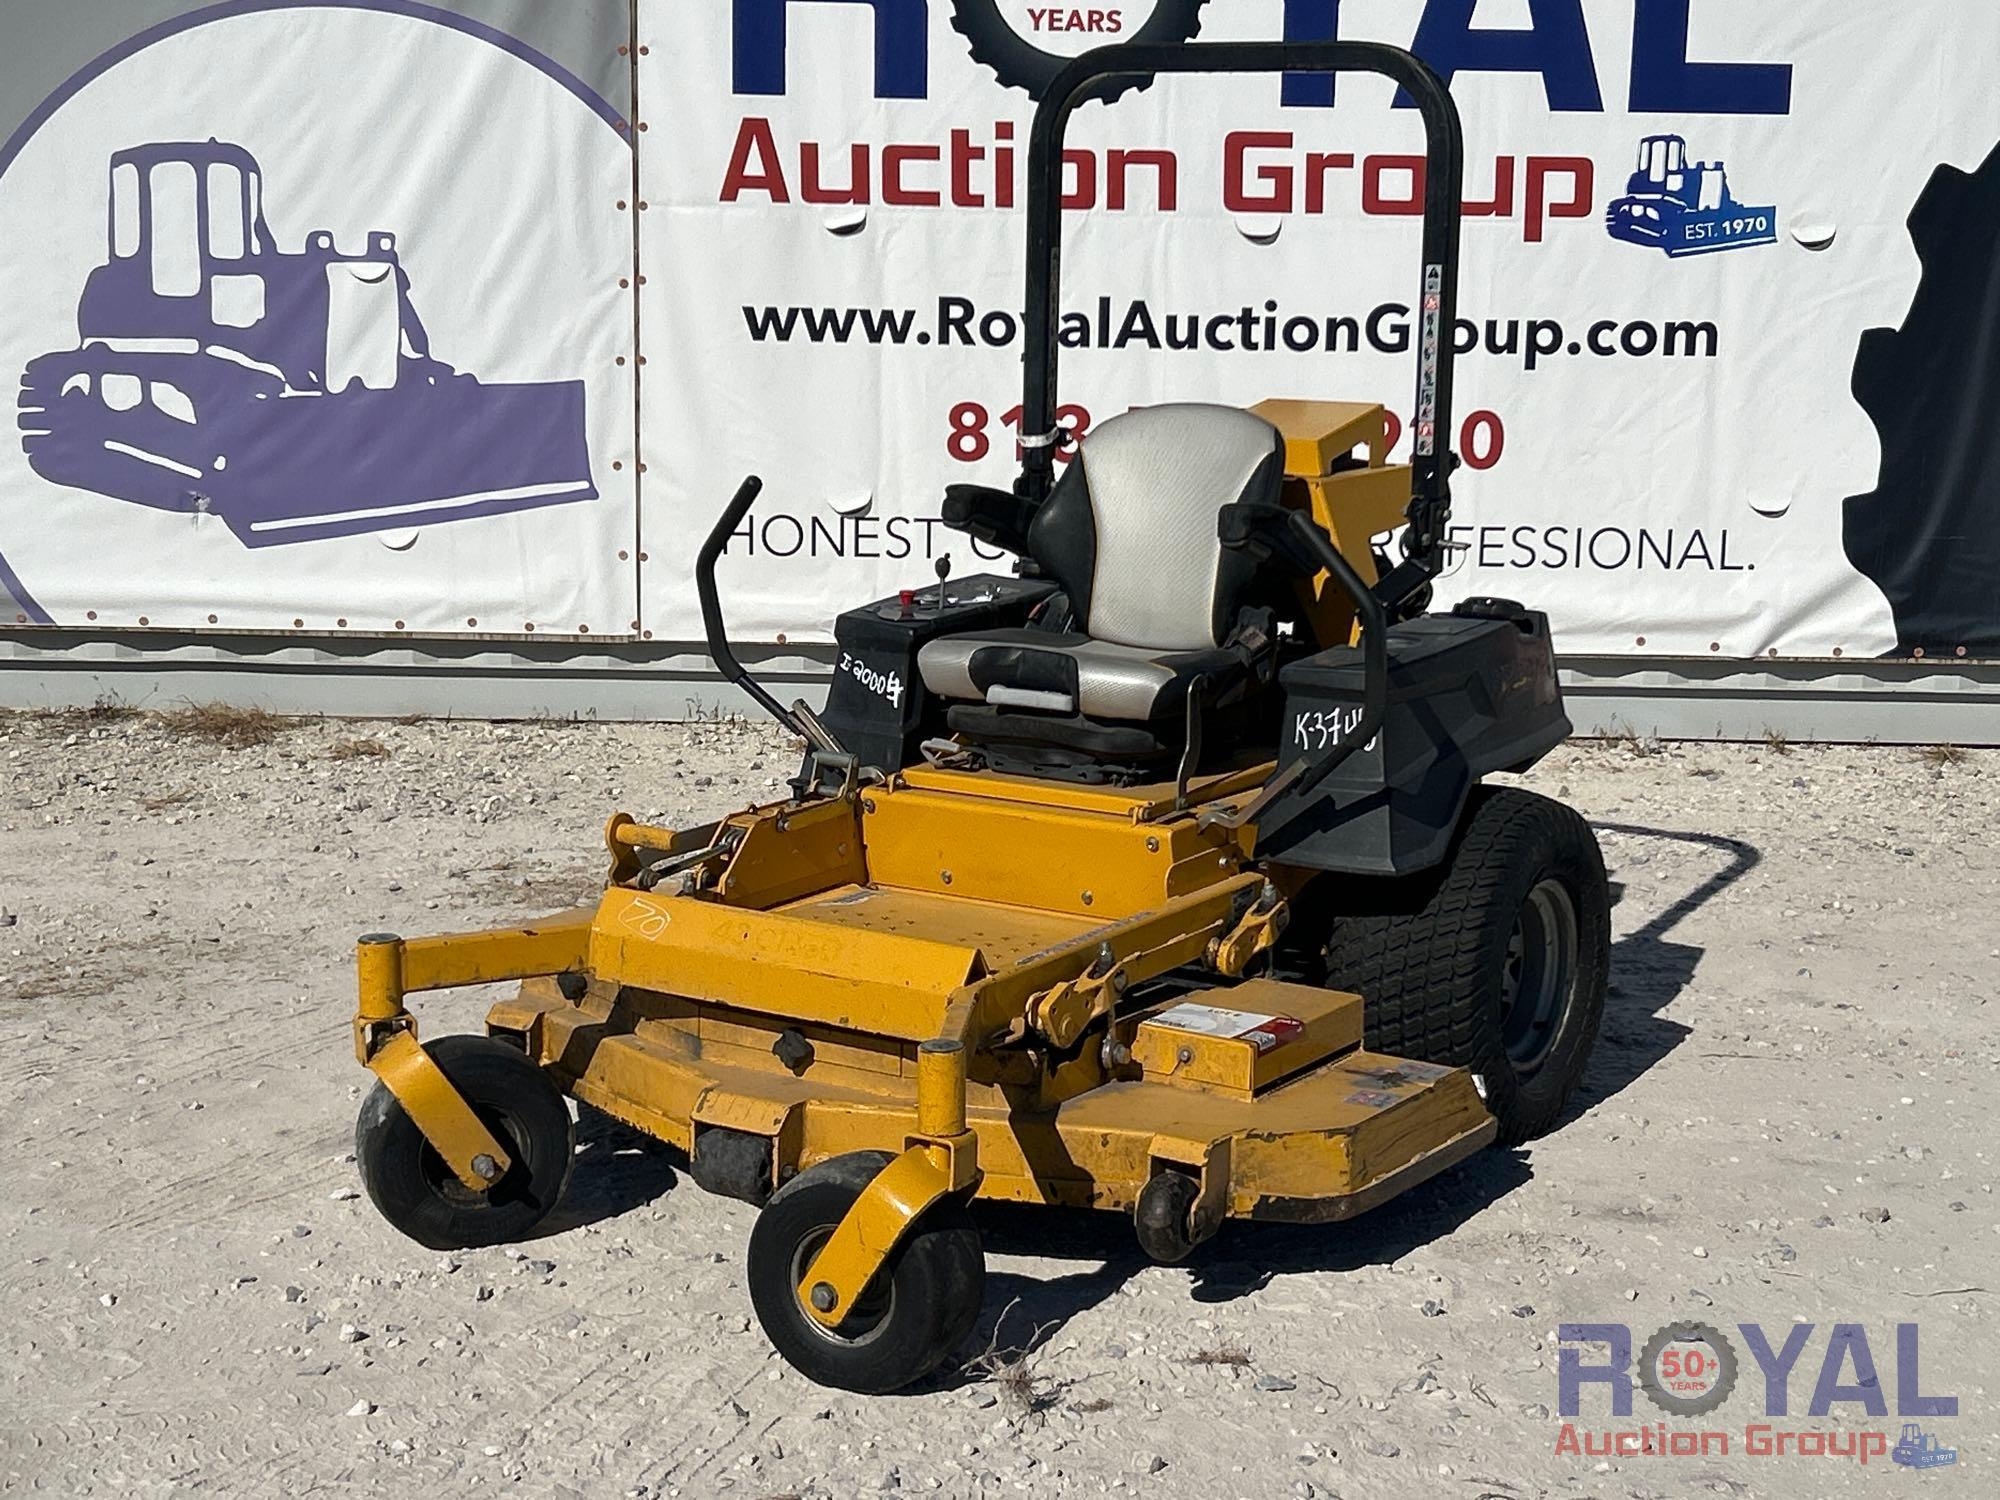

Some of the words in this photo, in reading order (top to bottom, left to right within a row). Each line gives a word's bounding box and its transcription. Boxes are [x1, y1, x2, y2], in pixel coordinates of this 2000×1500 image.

[1028, 8, 1123, 34] YEARS
[1224, 131, 1594, 242] Group
[1685, 222, 1718, 240] EST.
[1722, 216, 1767, 236] 1970
[742, 296, 1718, 371] www.RoalAuctionGoup.com
